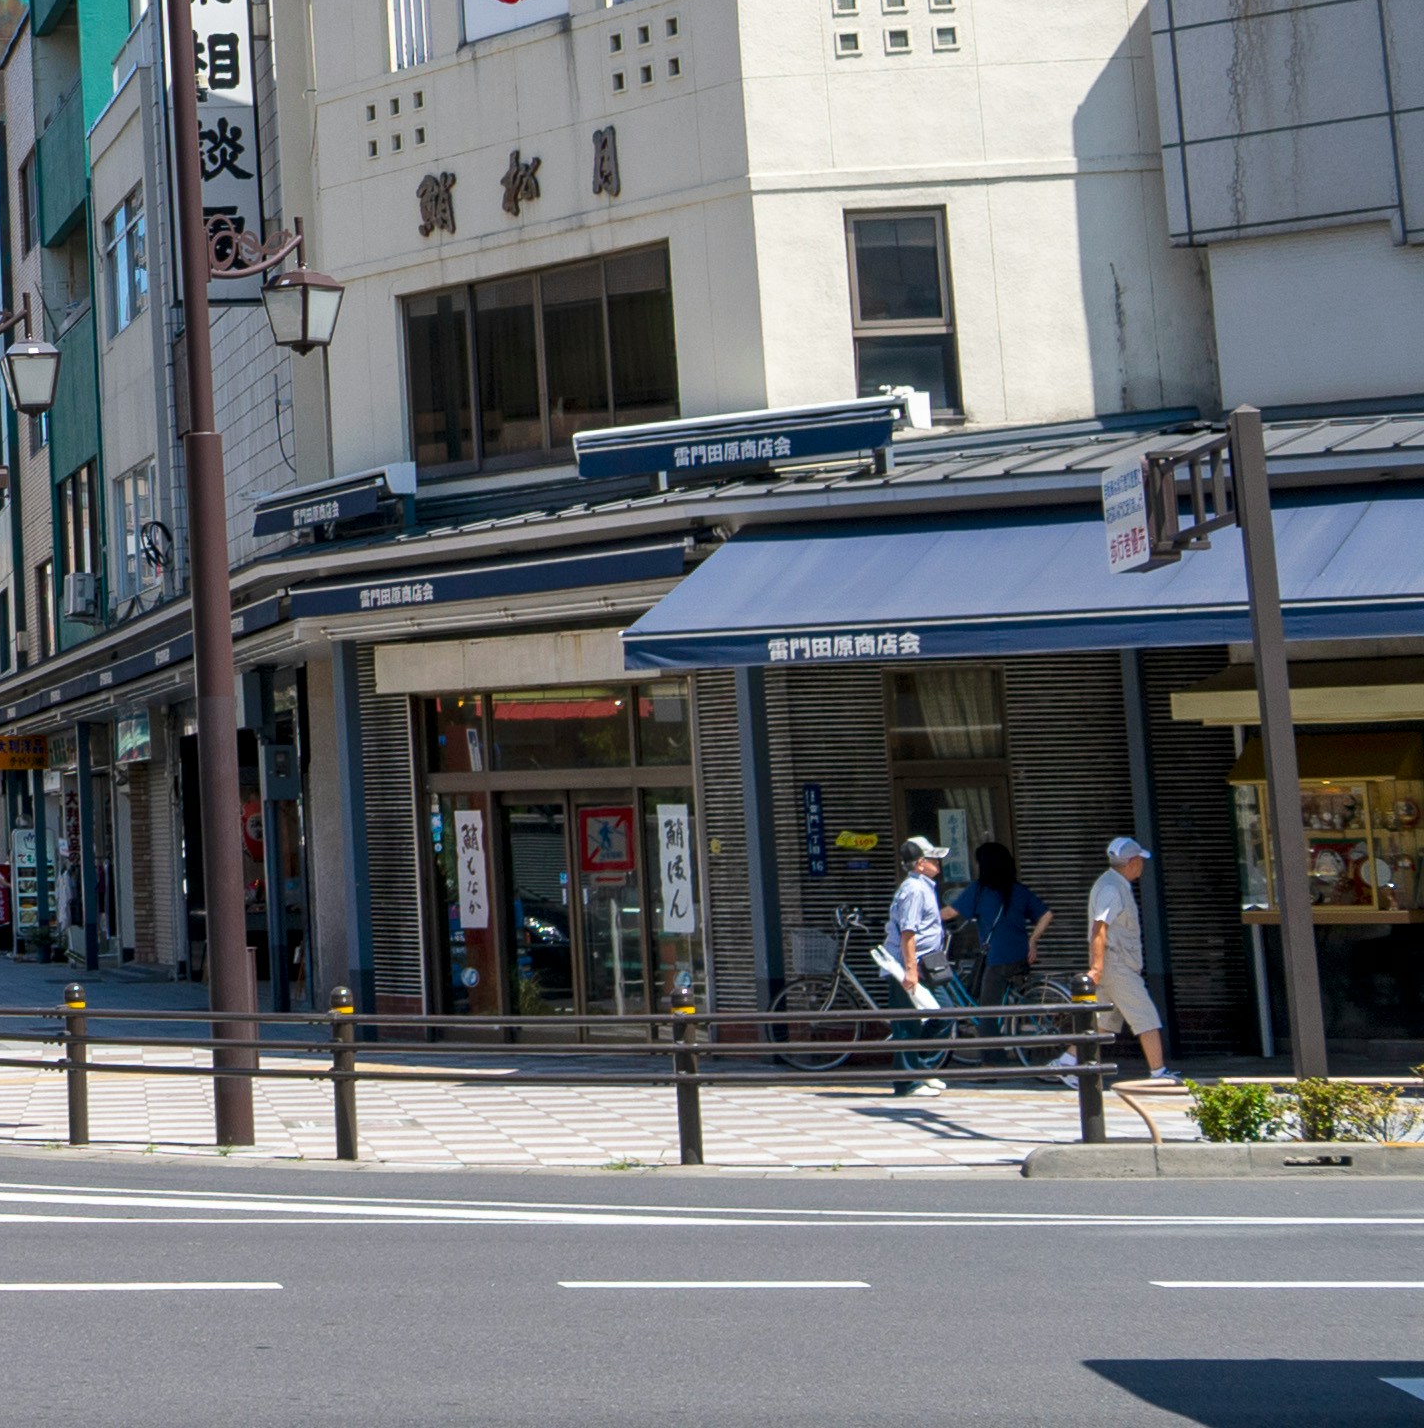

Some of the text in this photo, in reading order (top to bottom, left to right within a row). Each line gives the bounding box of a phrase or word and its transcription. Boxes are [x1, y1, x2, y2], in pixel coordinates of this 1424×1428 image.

[674, 436, 792, 468] 雷門田原商店会
[293, 501, 340, 525] 雷門田原商店会
[359, 583, 434, 609] 雷門田原商店会
[768, 632, 921, 661] 雷門田原商店会
